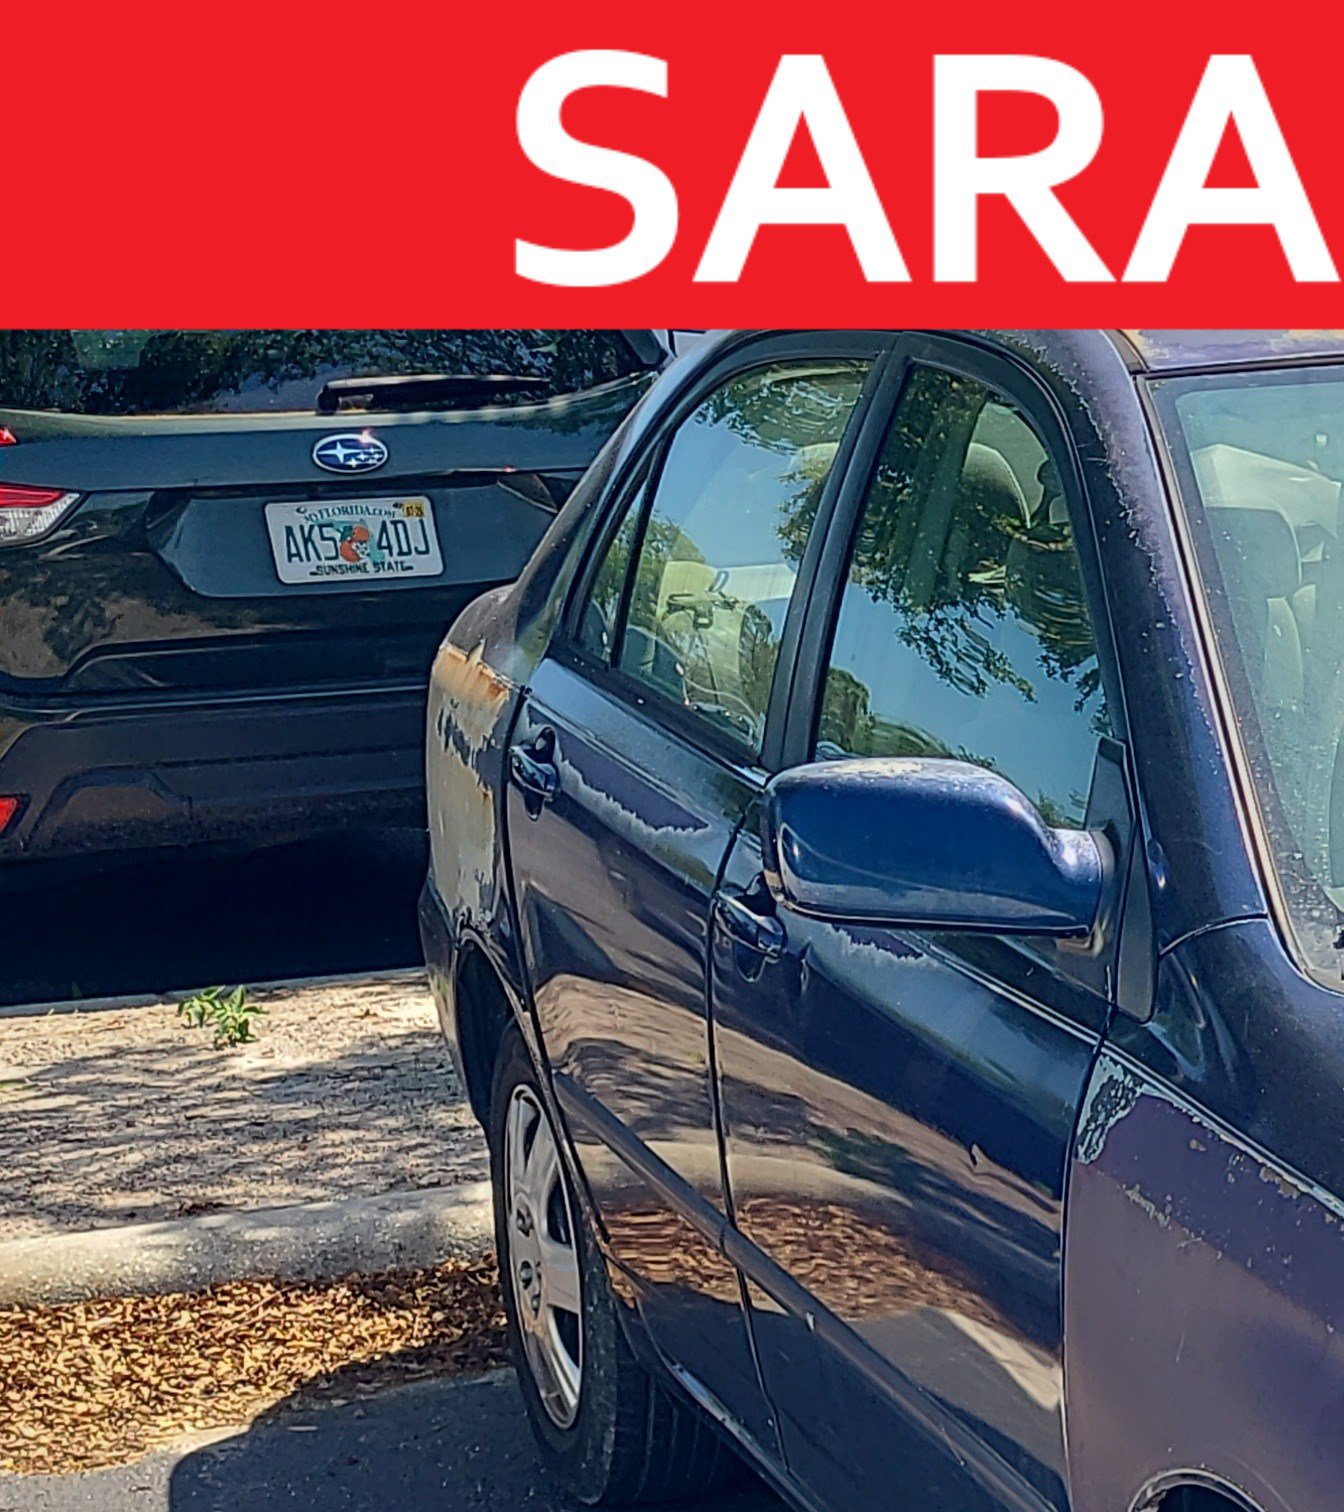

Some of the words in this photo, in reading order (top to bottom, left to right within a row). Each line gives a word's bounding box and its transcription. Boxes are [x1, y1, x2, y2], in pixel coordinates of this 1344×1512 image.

[285, 523, 339, 563] AK5
[377, 518, 430, 557] 4DJ
[316, 562, 369, 576] SUNSHINE
[372, 560, 406, 573] STATE
